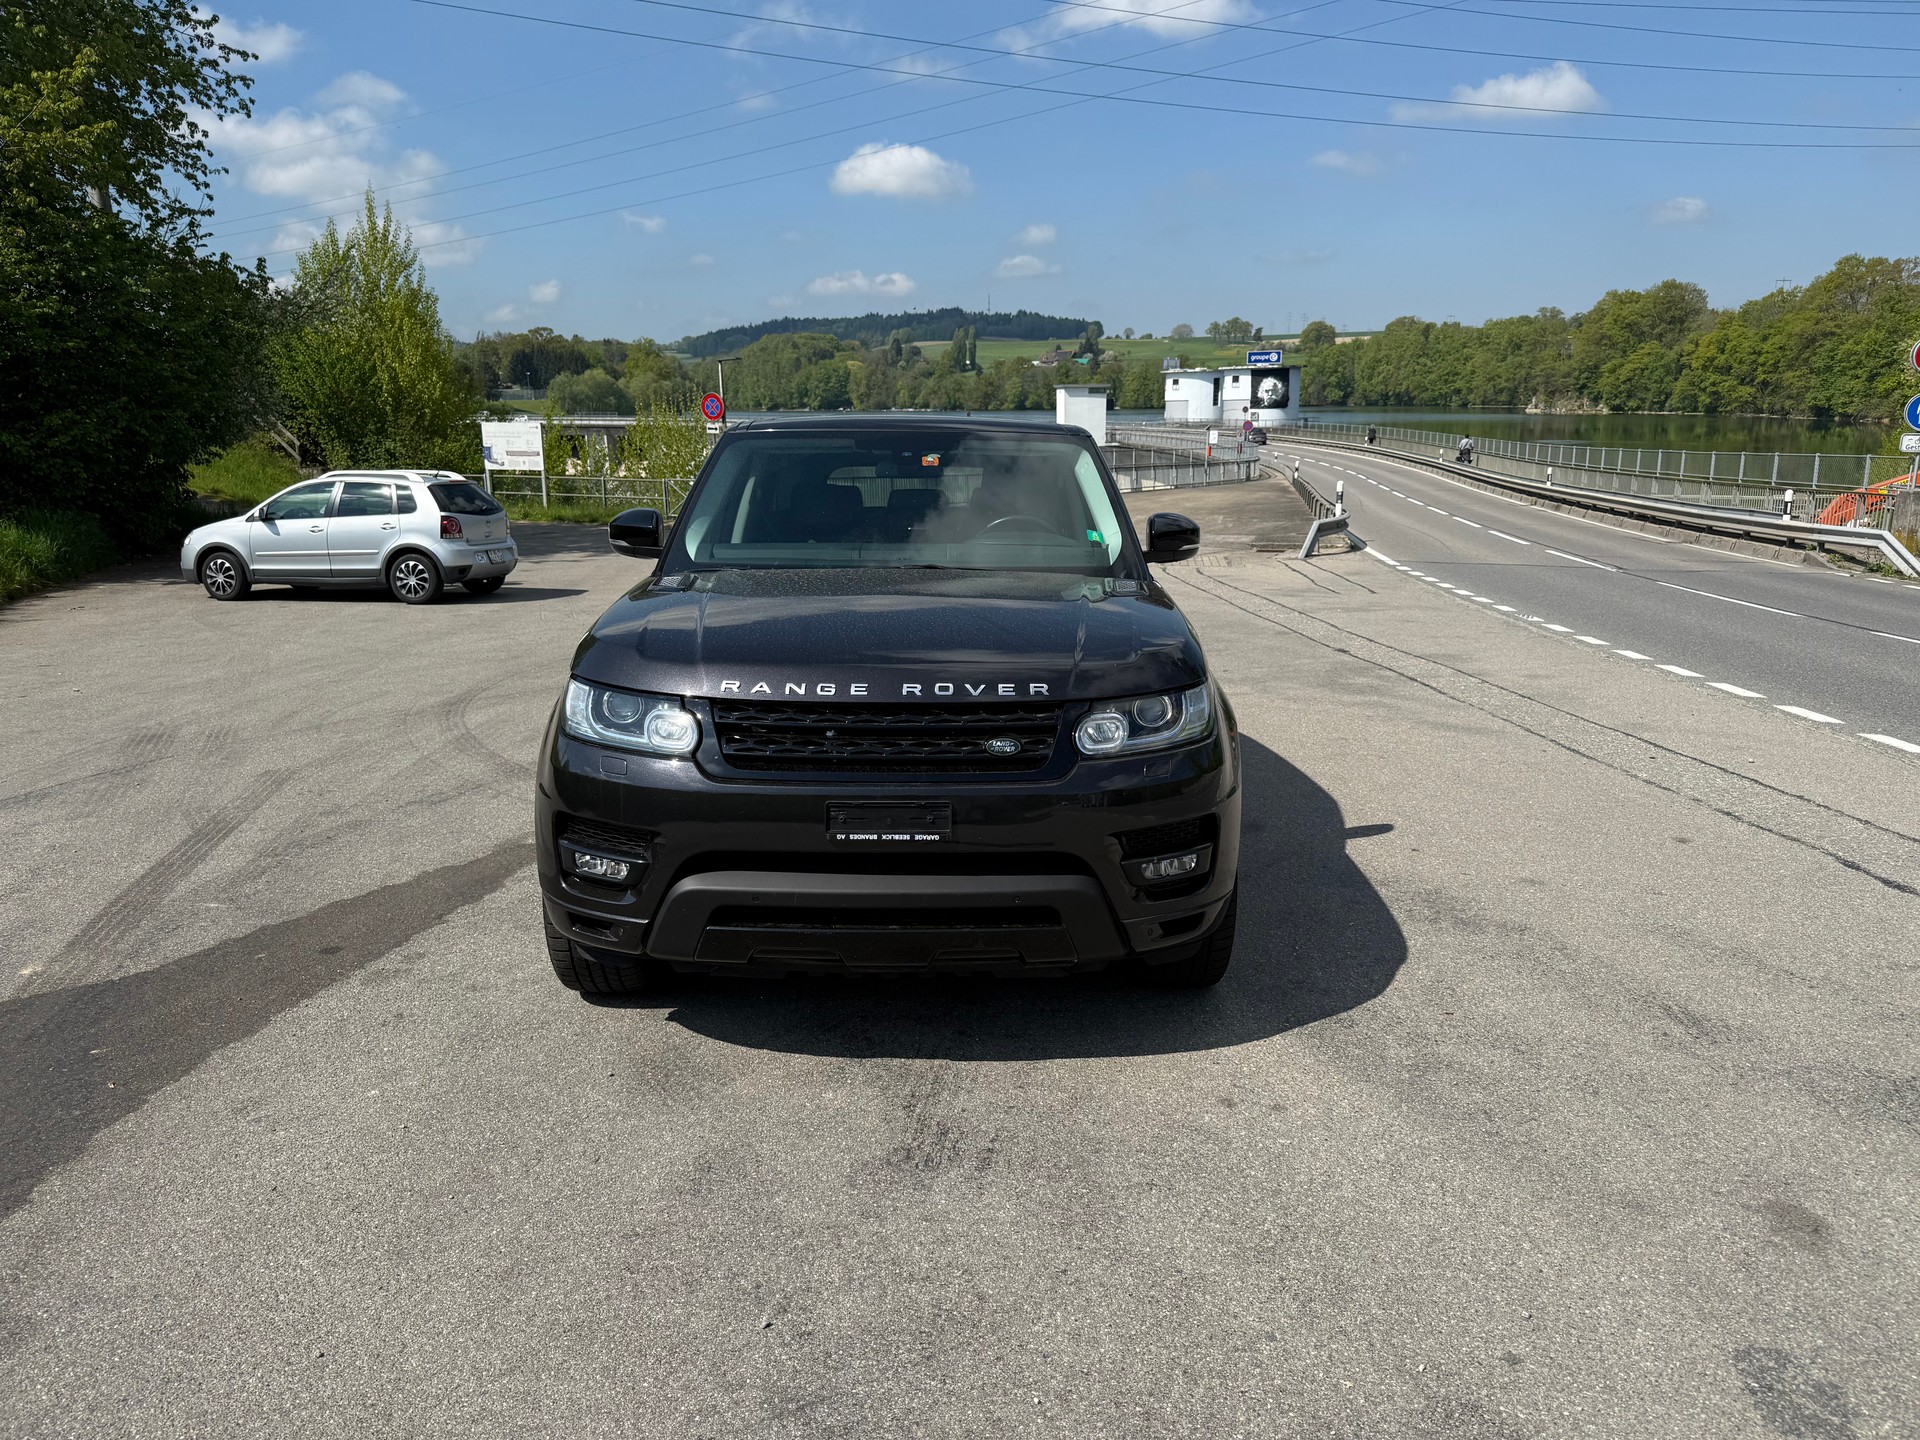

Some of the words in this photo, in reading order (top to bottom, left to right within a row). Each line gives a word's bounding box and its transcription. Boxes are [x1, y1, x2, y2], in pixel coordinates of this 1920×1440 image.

[1250, 354, 1270, 362] groupe
[720, 680, 869, 696] RANGE
[902, 682, 1050, 696] ROVER
